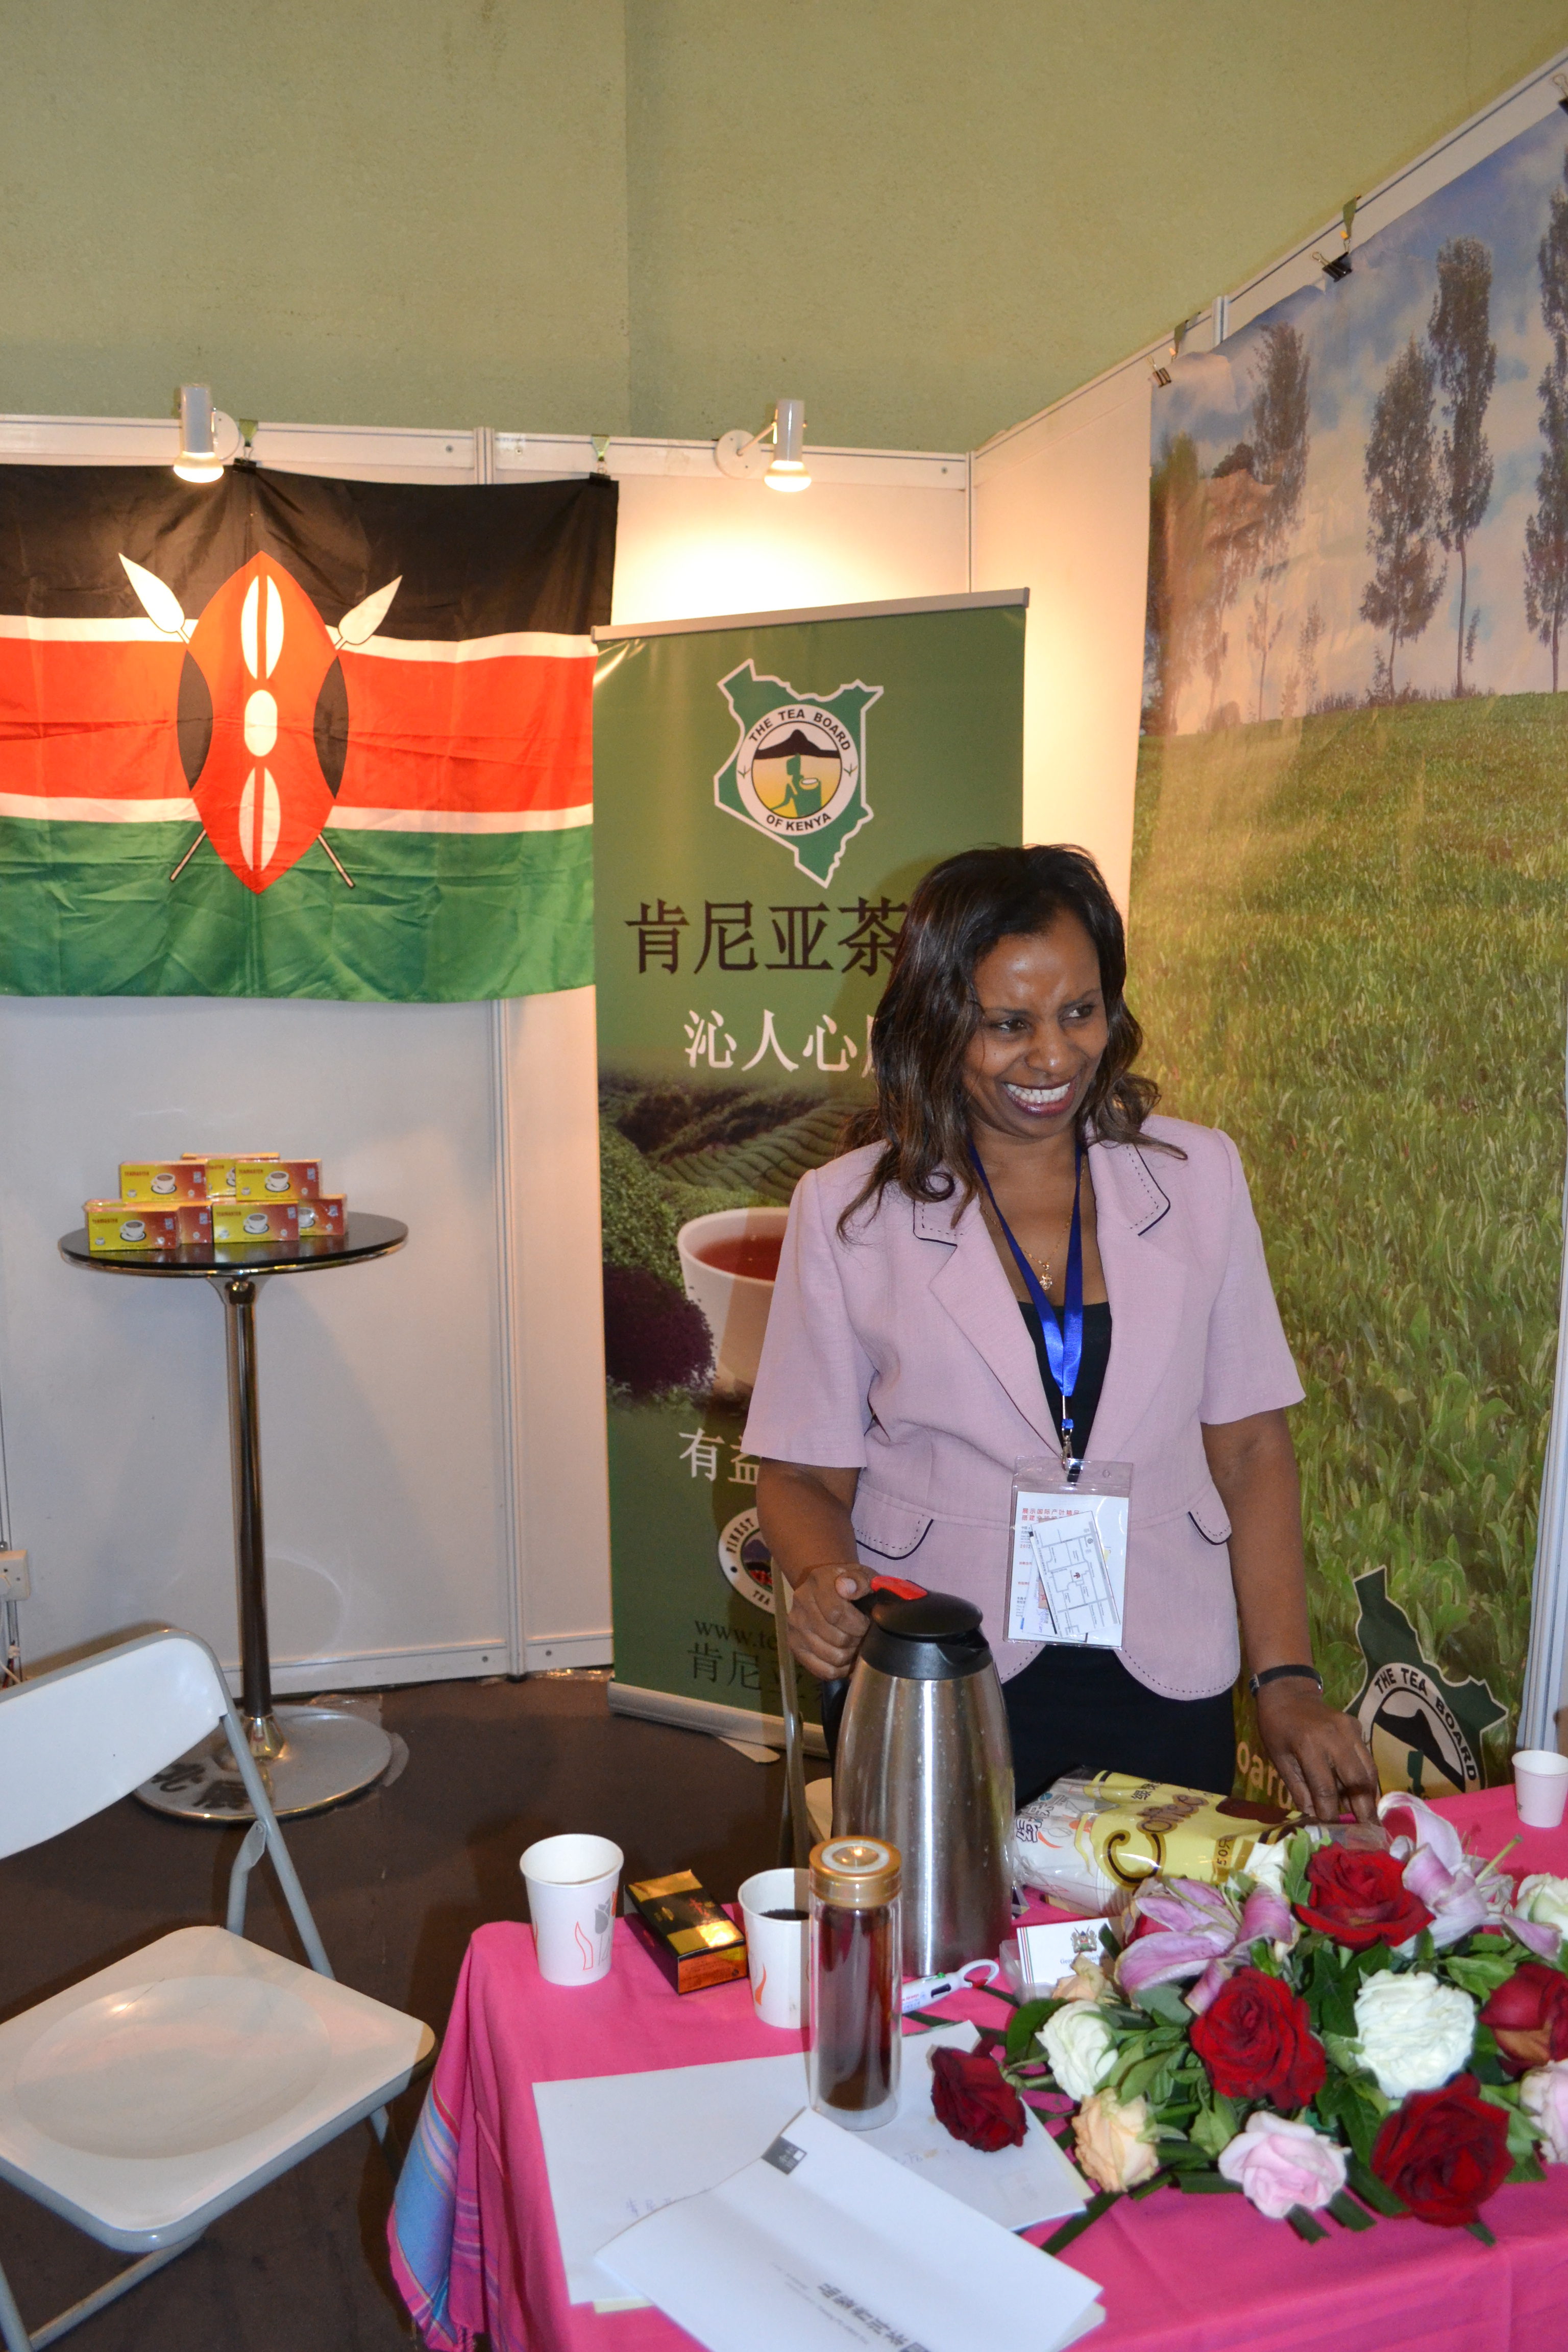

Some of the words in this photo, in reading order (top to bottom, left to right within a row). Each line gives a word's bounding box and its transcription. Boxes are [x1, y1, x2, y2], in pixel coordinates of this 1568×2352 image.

[749, 718, 773, 742] THE
[778, 708, 805, 721] TEA
[813, 712, 851, 750] BOARD
[766, 814, 783, 827] OF
[786, 812, 831, 831] KENYA
[684, 1009, 875, 1078] 沁人心
[1374, 1668, 1396, 1694] THE
[1401, 1667, 1428, 1696] TEA
[1435, 1697, 1477, 1780] BOARD
